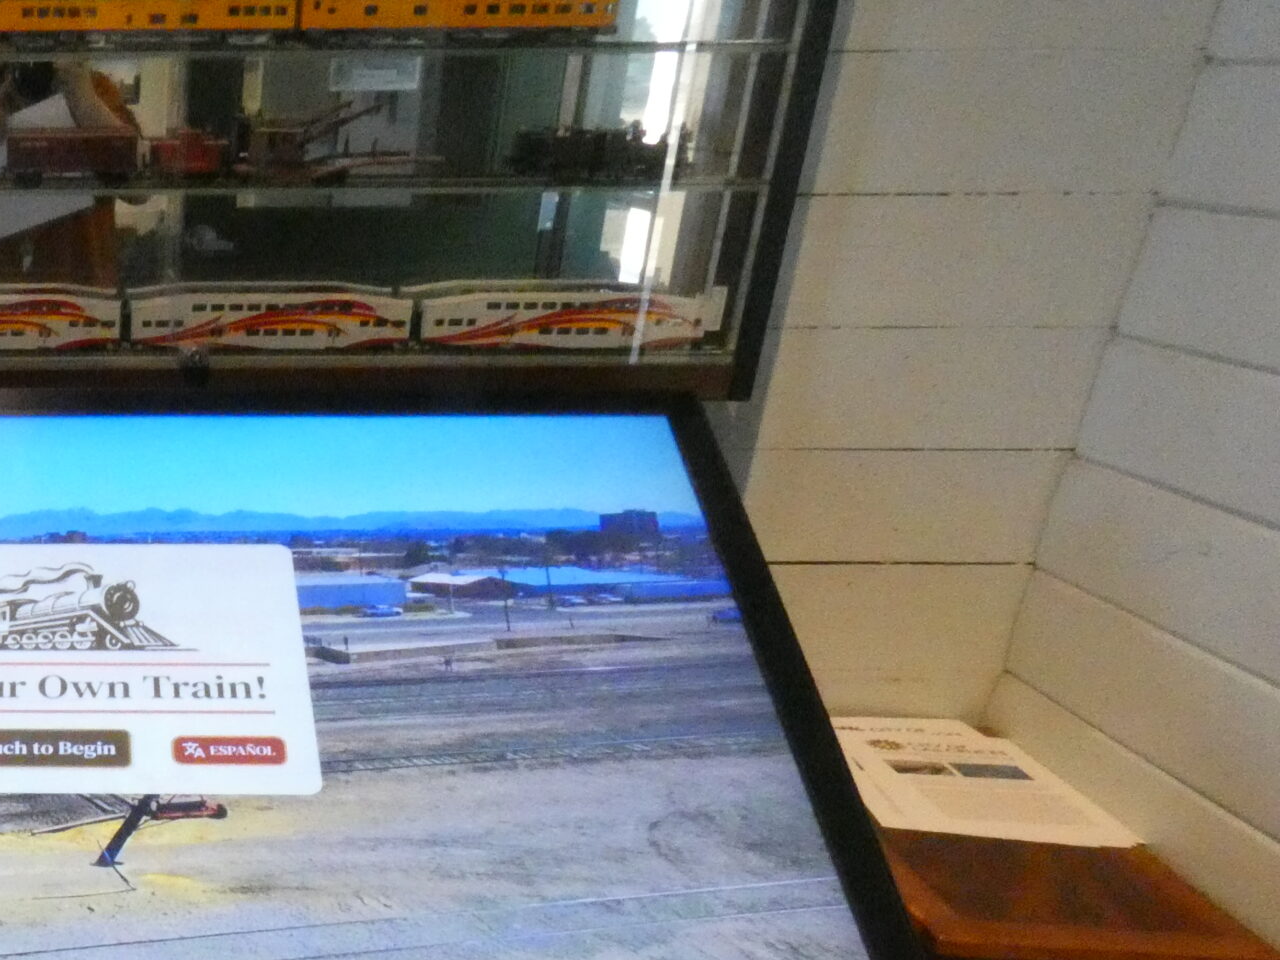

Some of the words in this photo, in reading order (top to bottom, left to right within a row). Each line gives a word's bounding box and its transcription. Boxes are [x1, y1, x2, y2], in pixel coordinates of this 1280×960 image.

[37, 674, 132, 699] Own
[142, 674, 267, 699] Train!
[32, 741, 54, 755] to
[58, 740, 117, 759] Begin
[209, 743, 276, 756] ESPAÑOL
